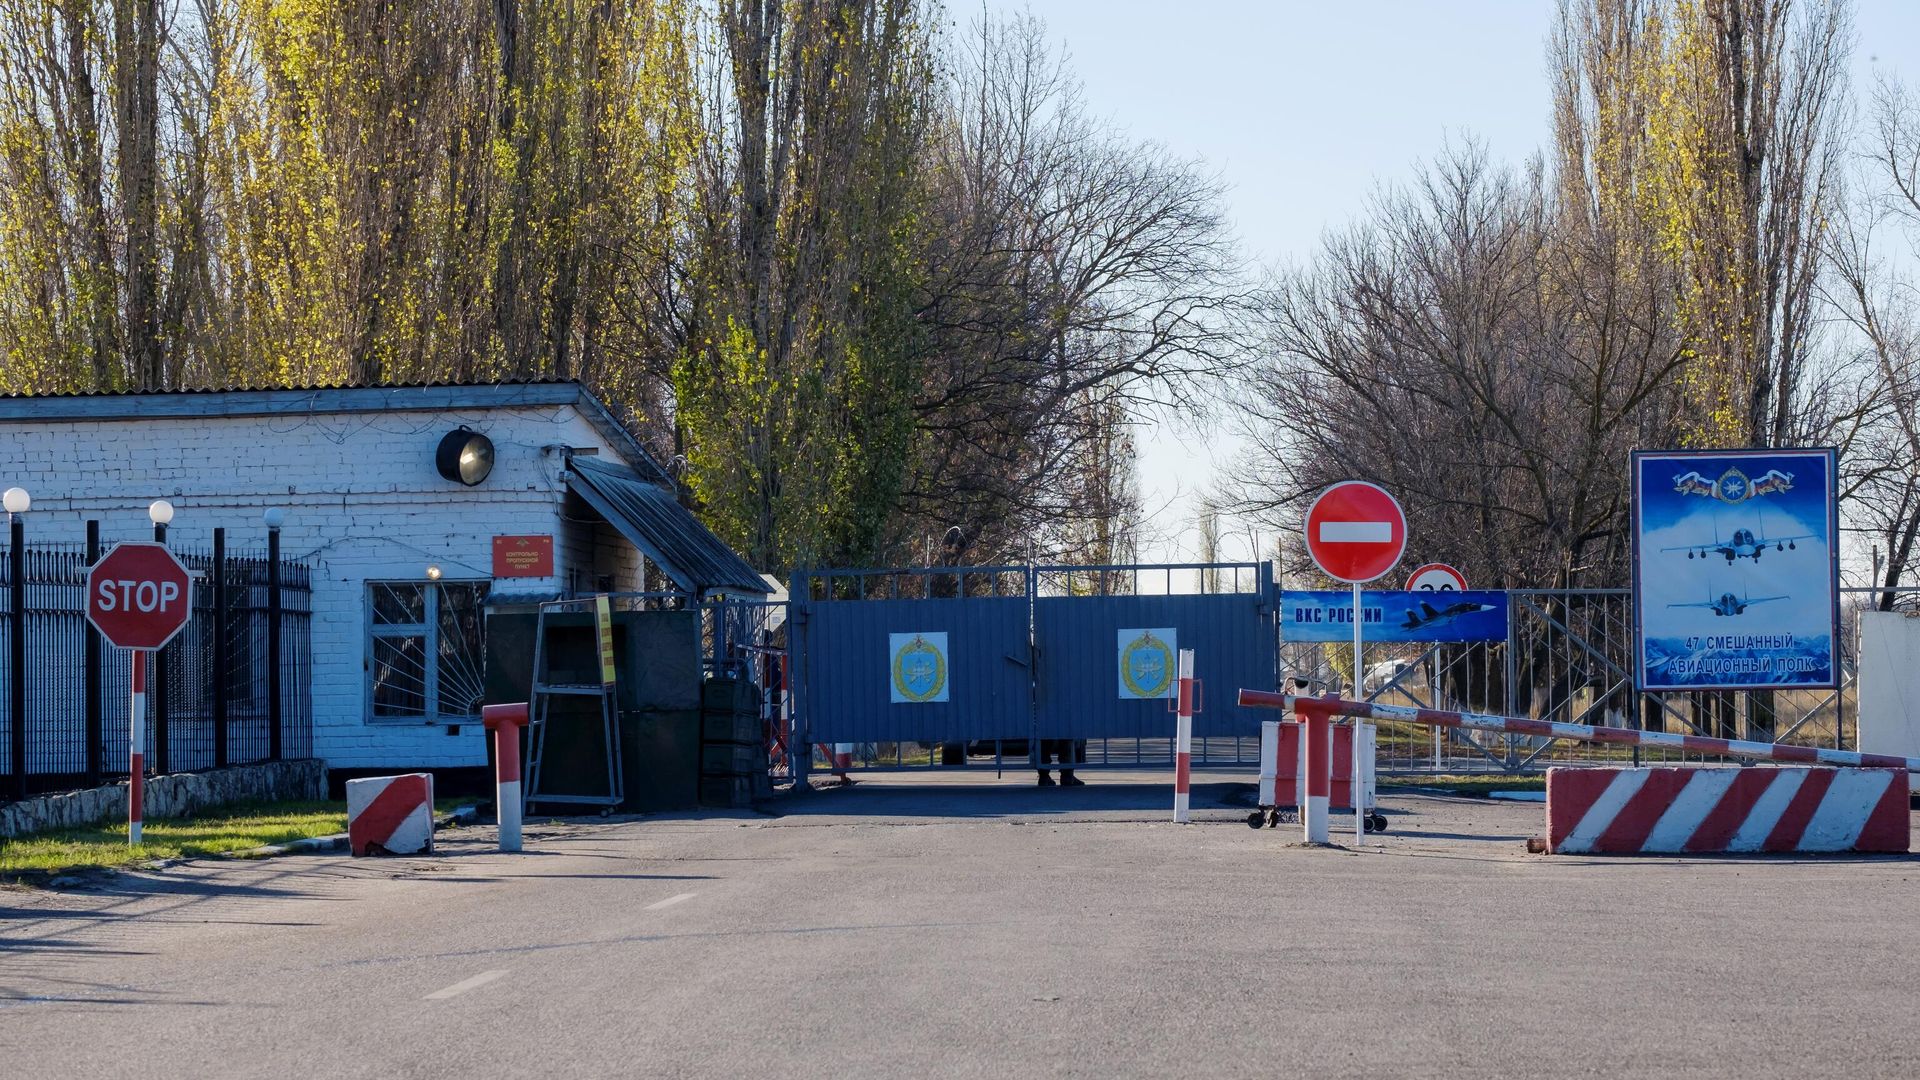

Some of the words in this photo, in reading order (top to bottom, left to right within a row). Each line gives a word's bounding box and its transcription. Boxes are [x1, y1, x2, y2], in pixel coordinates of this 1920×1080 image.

[98, 579, 179, 612] STOP
[1295, 607, 1322, 623] ВКС
[1328, 607, 1382, 623] РОСИИ
[1685, 636, 1700, 650] 47
[1706, 632, 1794, 650] СМЕШАННЫЙ
[1668, 656, 1771, 675] АВИАЦИОННЫЙ
[1777, 656, 1813, 673] ПОЛК
